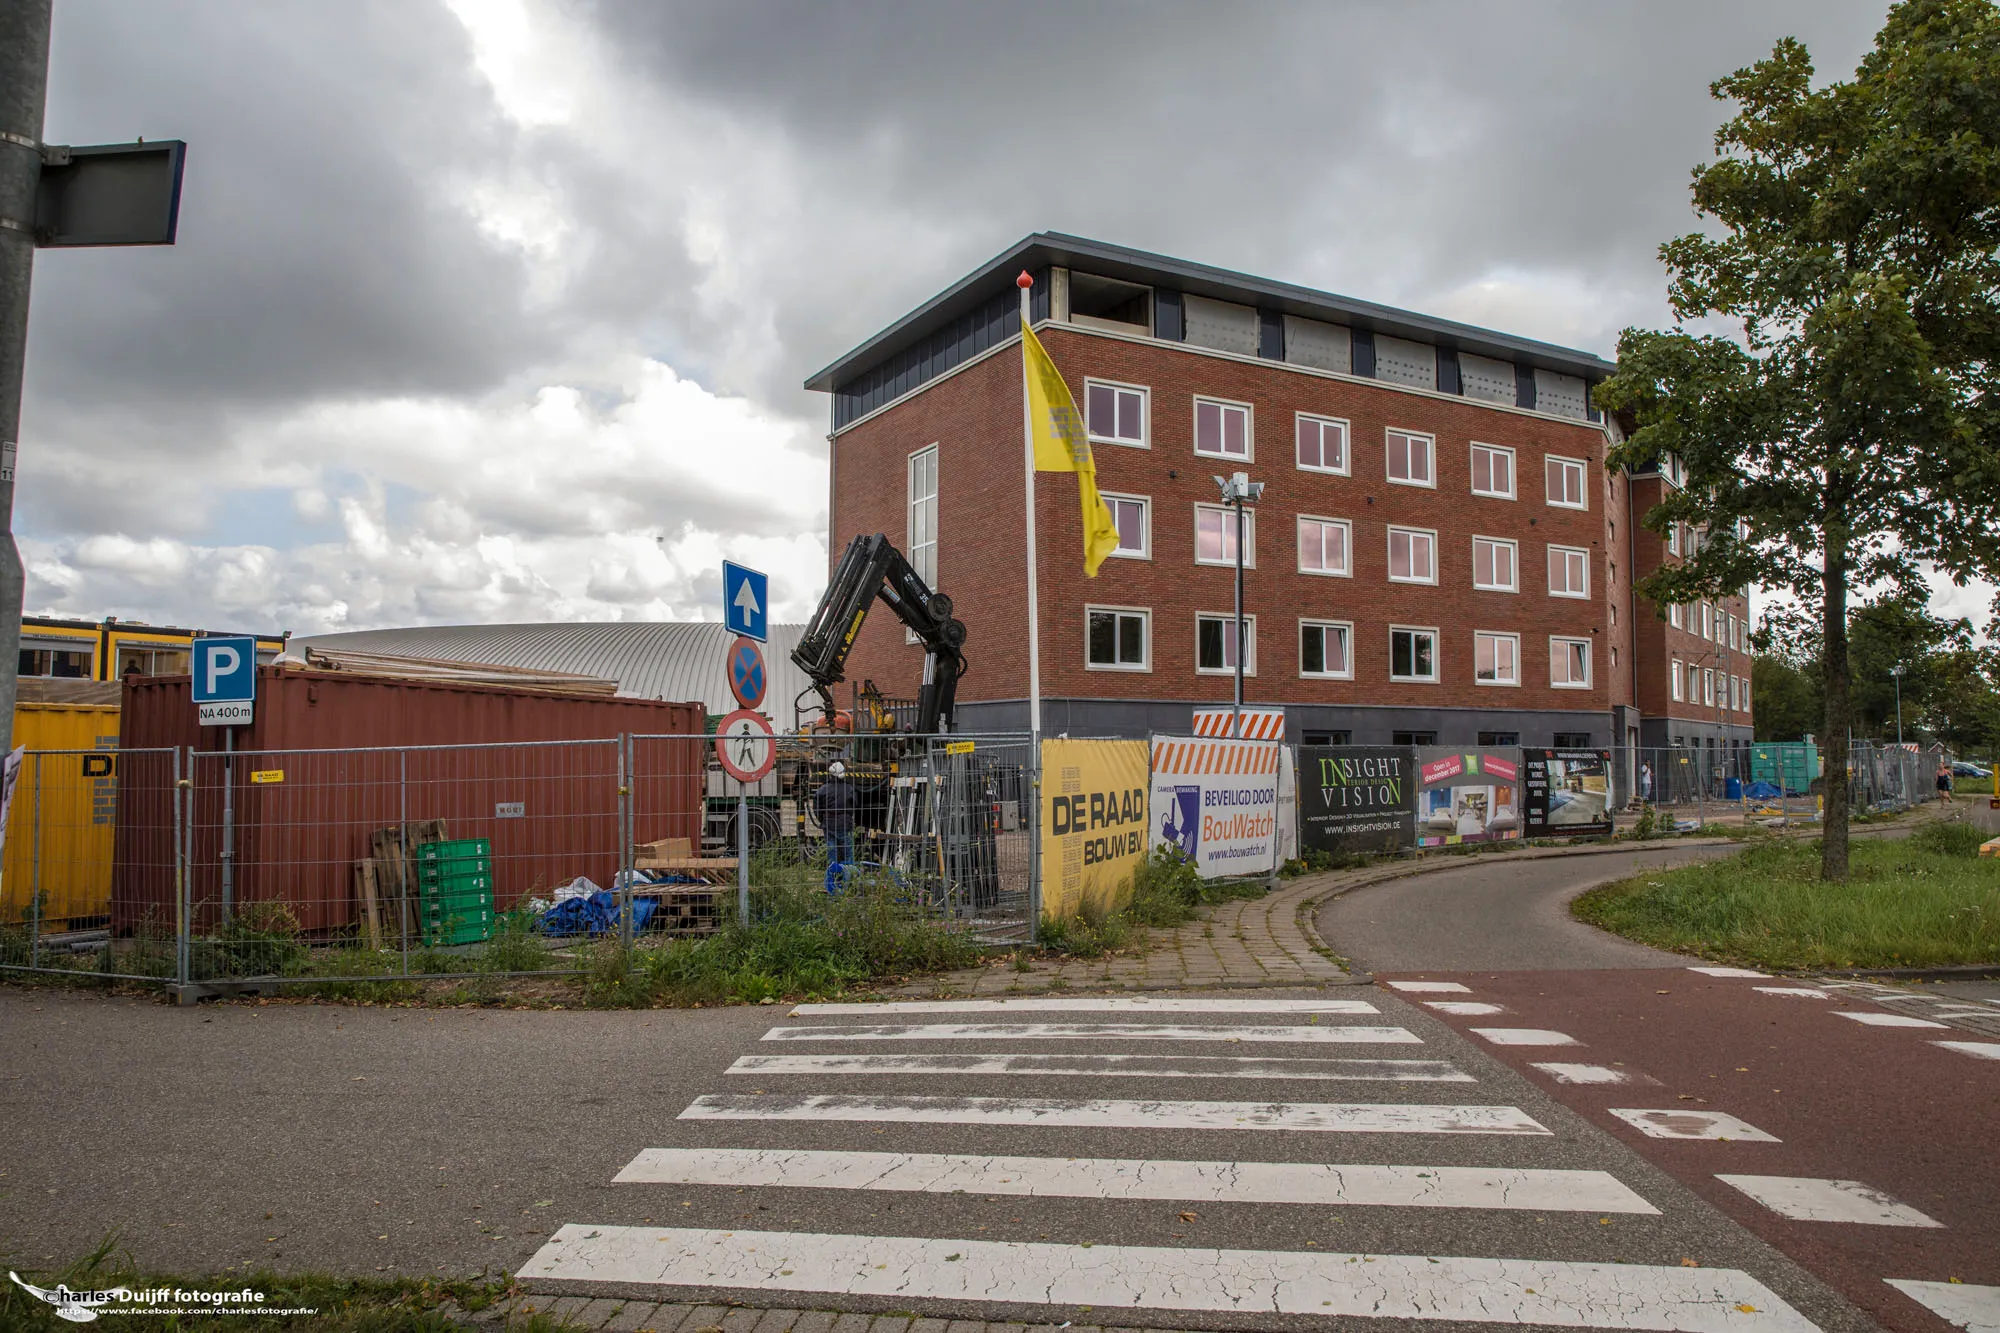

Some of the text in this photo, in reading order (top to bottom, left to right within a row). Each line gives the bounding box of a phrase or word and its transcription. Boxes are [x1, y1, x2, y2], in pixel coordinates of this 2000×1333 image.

[207, 646, 240, 694] P
[200, 708, 215, 718] NA
[83, 755, 119, 776] D
[1319, 758, 1400, 787] INSIGHT
[1424, 765, 1460, 782] december 2017
[1433, 763, 1446, 771] Open
[1205, 790, 1251, 807] BEVEILIGD
[1252, 788, 1275, 805] DOOR
[1321, 777, 1401, 808] VISION
[1053, 788, 1143, 836] DE RAAD
[1203, 808, 1273, 842] BouWatch
[1084, 833, 1127, 866] BOUW
[1208, 841, 1267, 861] www.bouwatch.nl
